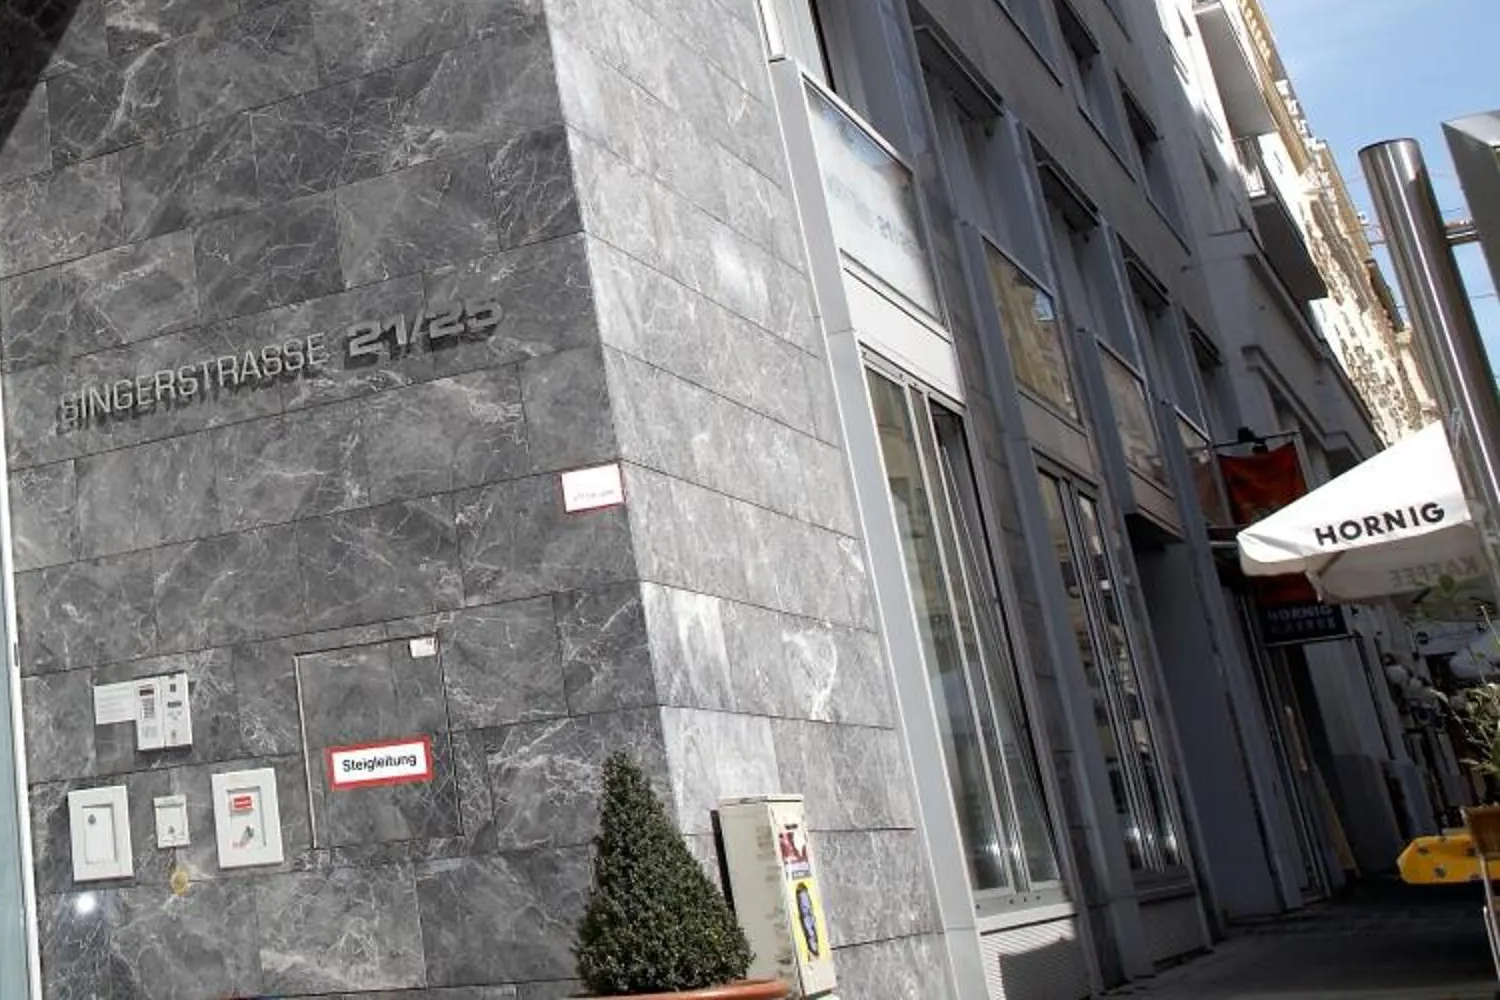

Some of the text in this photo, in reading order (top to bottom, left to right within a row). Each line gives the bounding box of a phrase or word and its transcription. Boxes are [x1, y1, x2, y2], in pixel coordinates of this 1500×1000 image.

[60, 300, 501, 423] SINGERSTRASSE 21/25
[1314, 502, 1445, 546] HORNIG
[342, 754, 417, 772] Steigleitung
